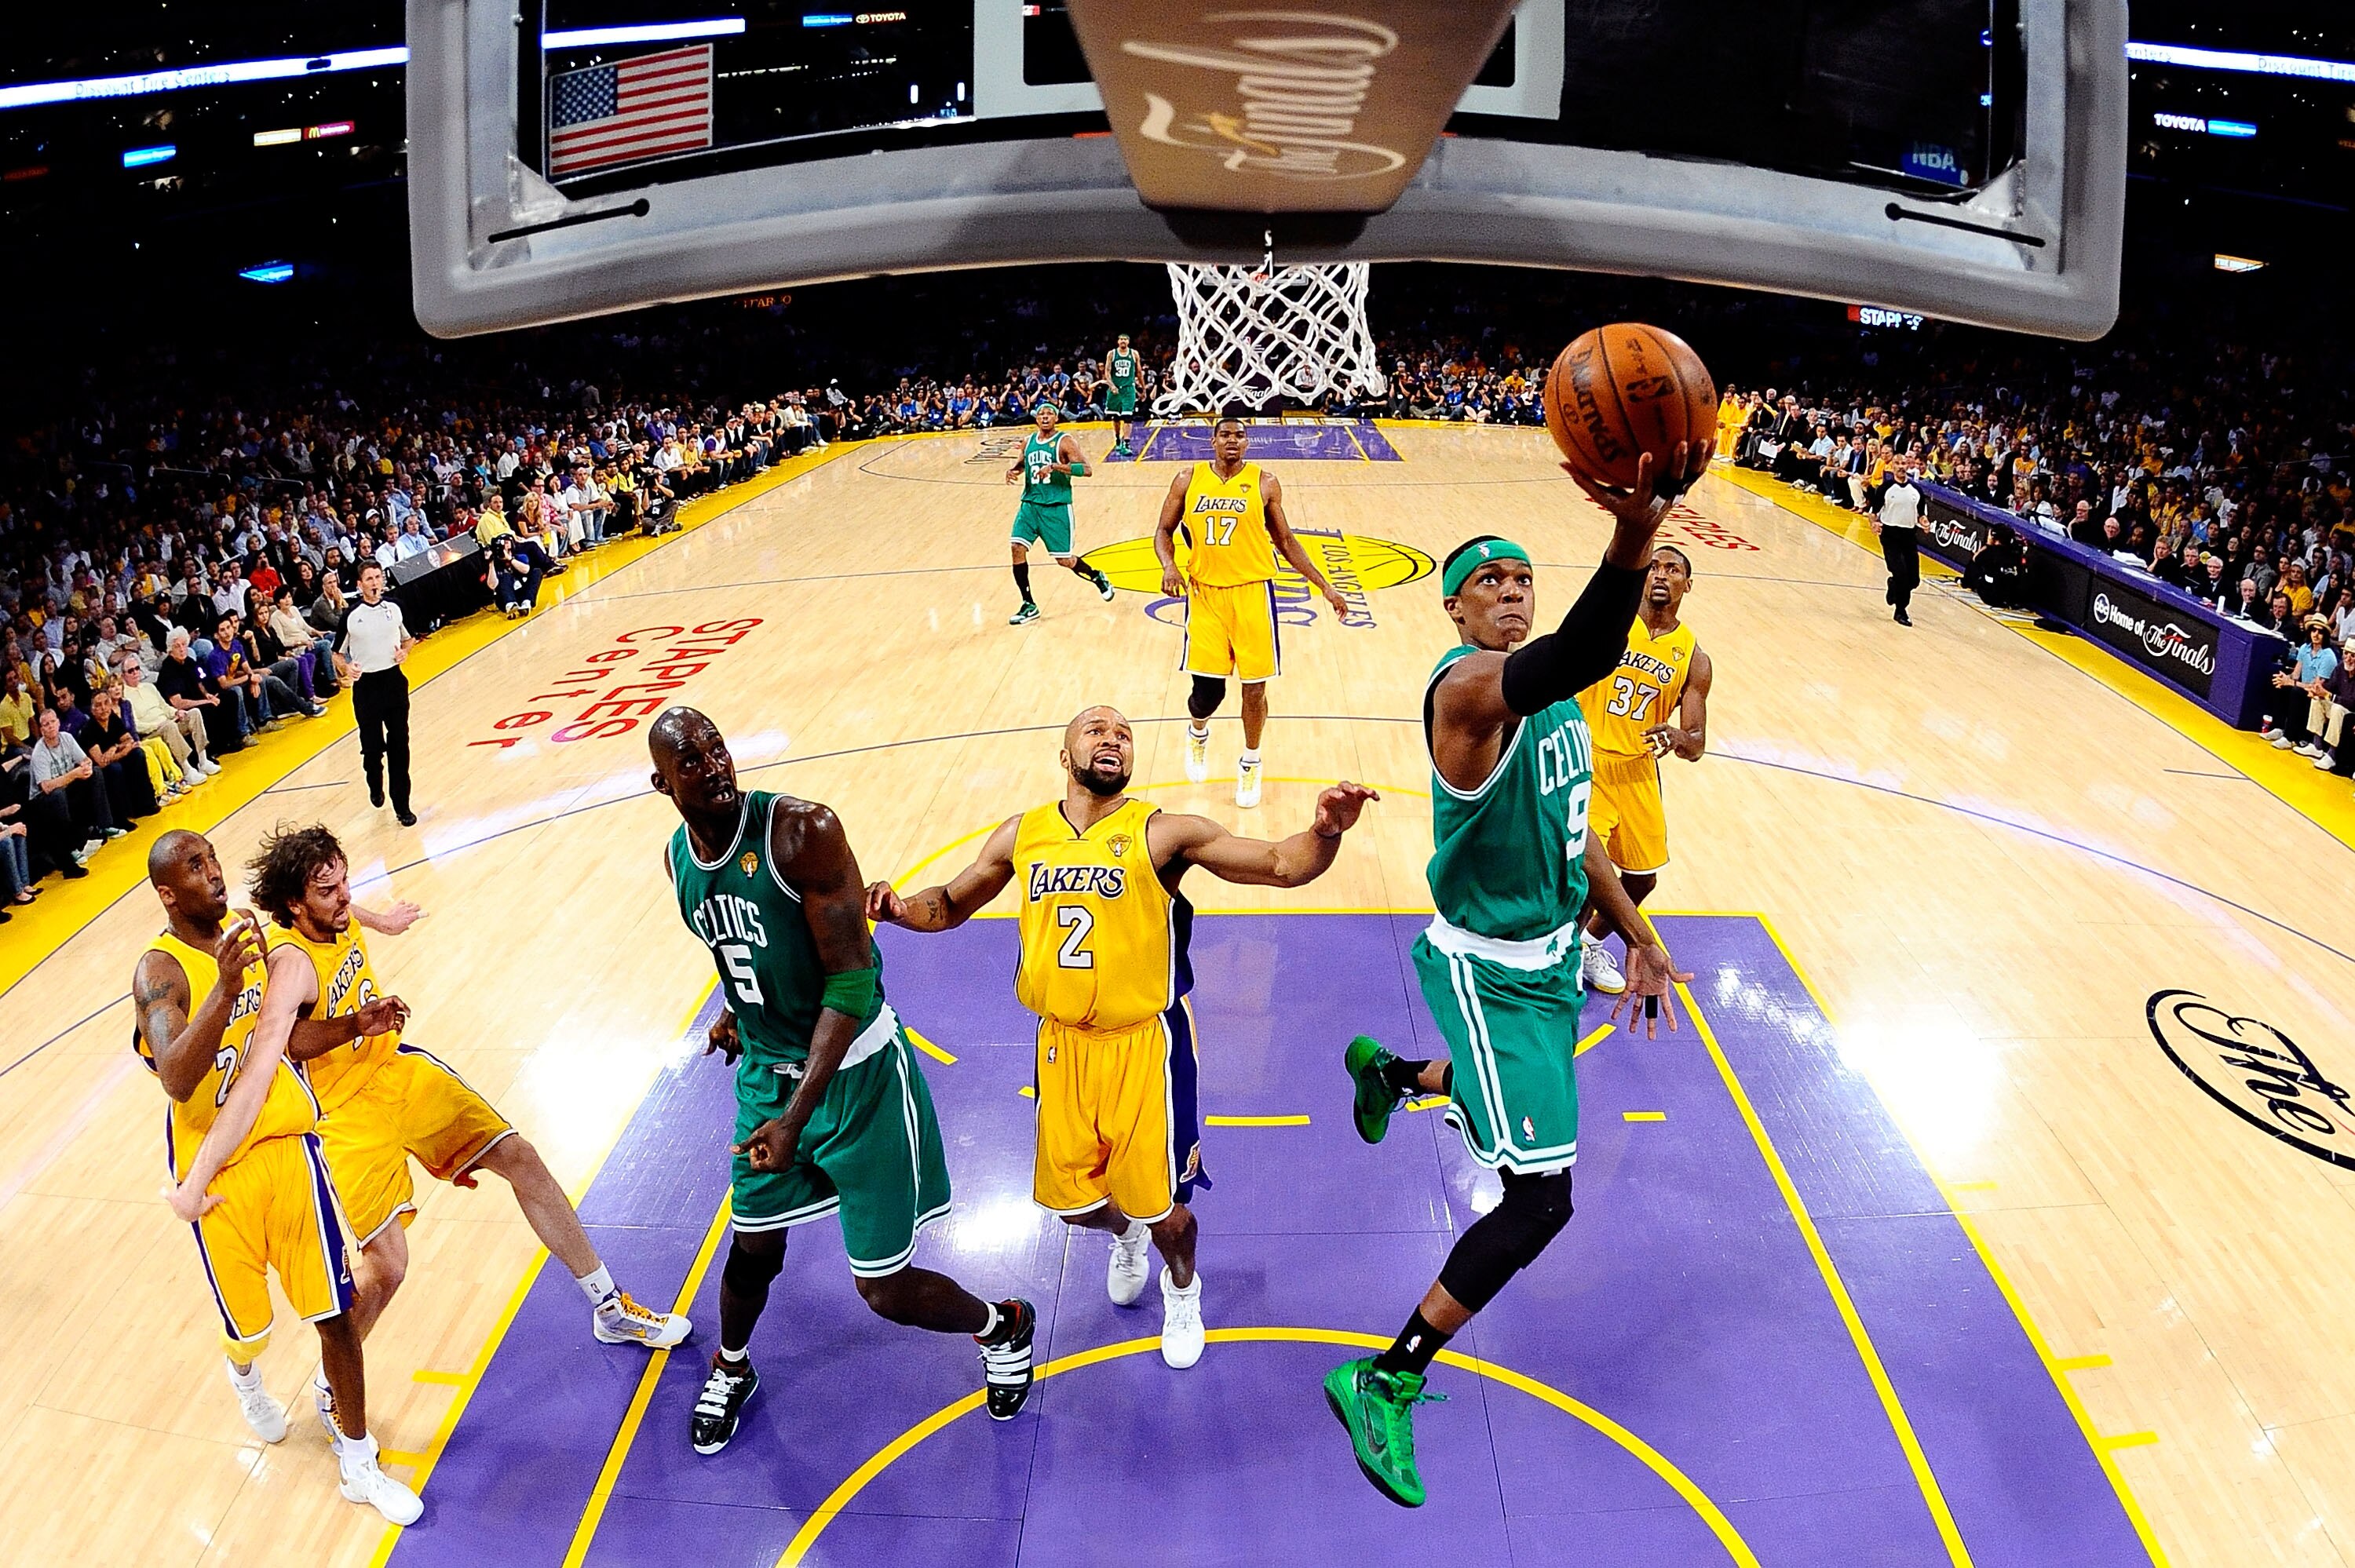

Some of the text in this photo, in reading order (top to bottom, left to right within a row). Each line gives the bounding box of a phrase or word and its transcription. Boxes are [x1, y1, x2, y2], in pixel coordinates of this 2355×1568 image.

[870, 12, 907, 23] TOYOTA
[2258, 57, 2322, 77] Discount
[2154, 113, 2207, 133] TOYOTA
[1115, 366, 1130, 377] 30
[1192, 495, 1247, 513] LAKERS
[1205, 516, 1238, 546] 17
[1935, 520, 1982, 553] Finals
[1321, 543, 1353, 564] LOS
[2109, 603, 2135, 632] Home
[2134, 618, 2145, 637] of
[2142, 622, 2216, 676] Finals
[2145, 625, 2167, 650] The
[550, 617, 765, 743] STAPLES
[1617, 651, 1675, 684] AKERS
[466, 625, 685, 749] Center
[1606, 675, 1662, 722] 37
[1539, 719, 1594, 797] CELTI
[1565, 779, 1592, 862] 9
[1029, 862, 1125, 903] LAKERS
[1057, 905, 1094, 970] 2
[718, 943, 765, 1006] 5
[225, 981, 262, 1030] ERS
